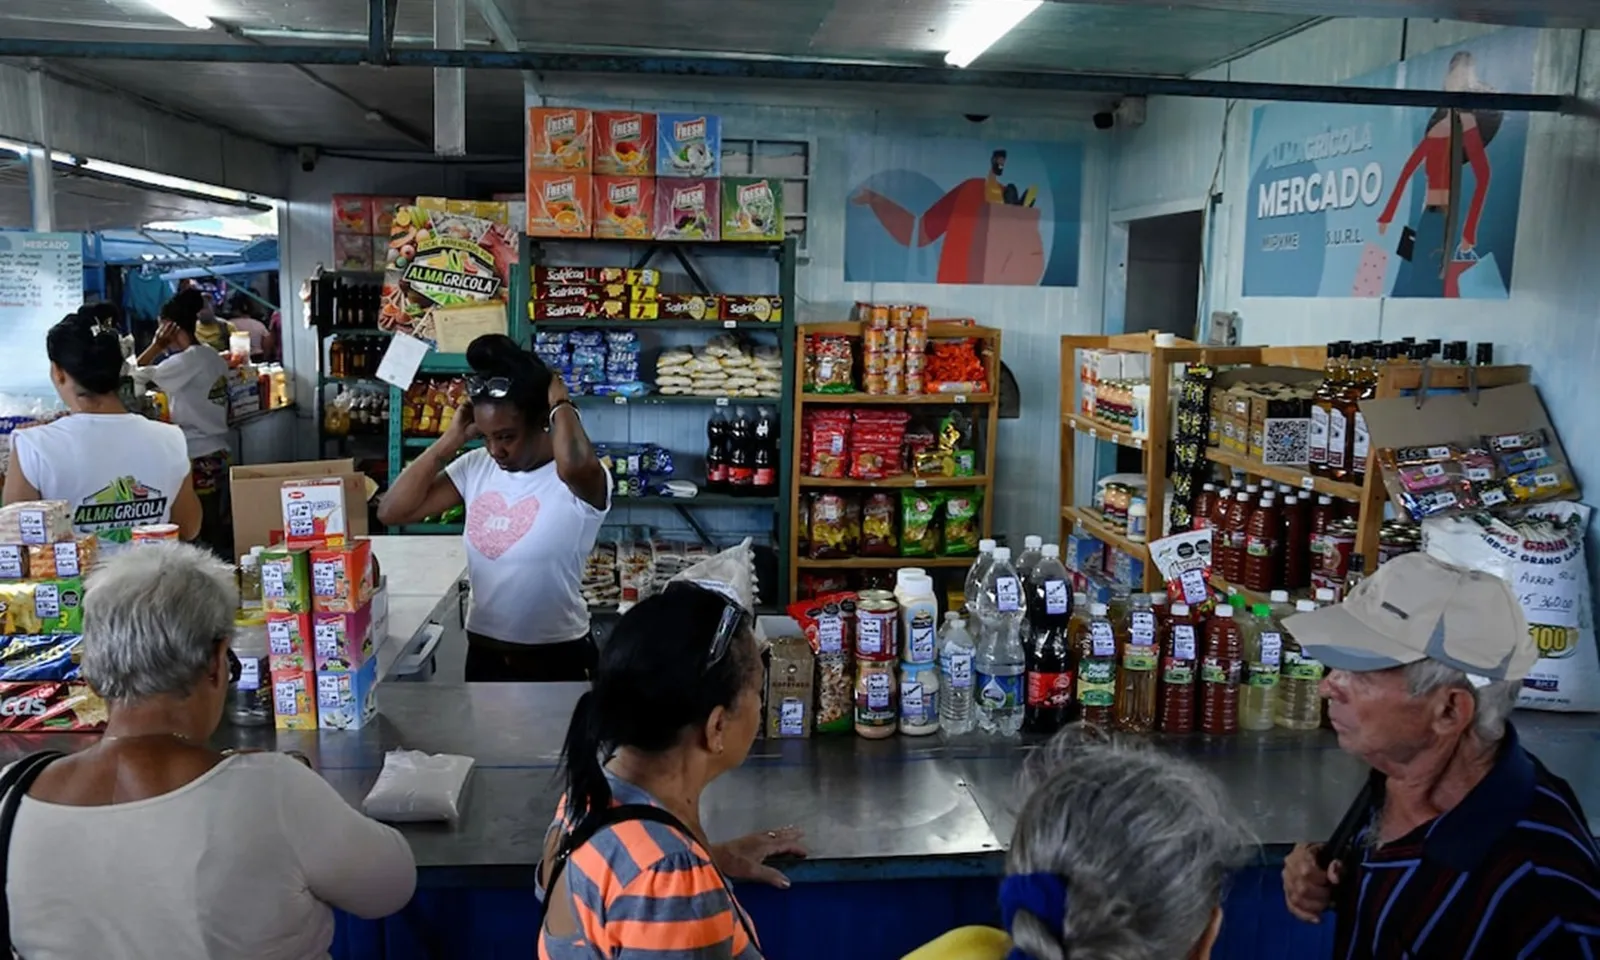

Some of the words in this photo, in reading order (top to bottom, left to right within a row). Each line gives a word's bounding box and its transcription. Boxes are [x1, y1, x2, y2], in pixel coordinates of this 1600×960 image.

[549, 116, 575, 133] FRESH
[613, 121, 639, 138] FRESH
[677, 124, 704, 139] FRESH
[546, 181, 573, 199] FRESH
[611, 185, 637, 201] FRESH
[677, 190, 704, 206] FRESH
[742, 188, 767, 203] FRESH
[1257, 162, 1383, 220] MERCADO
[638, 287, 647, 300] 7
[636, 306, 645, 318] 7
[1521, 554, 1562, 565] GRANO
[58, 611, 68, 628] 3
